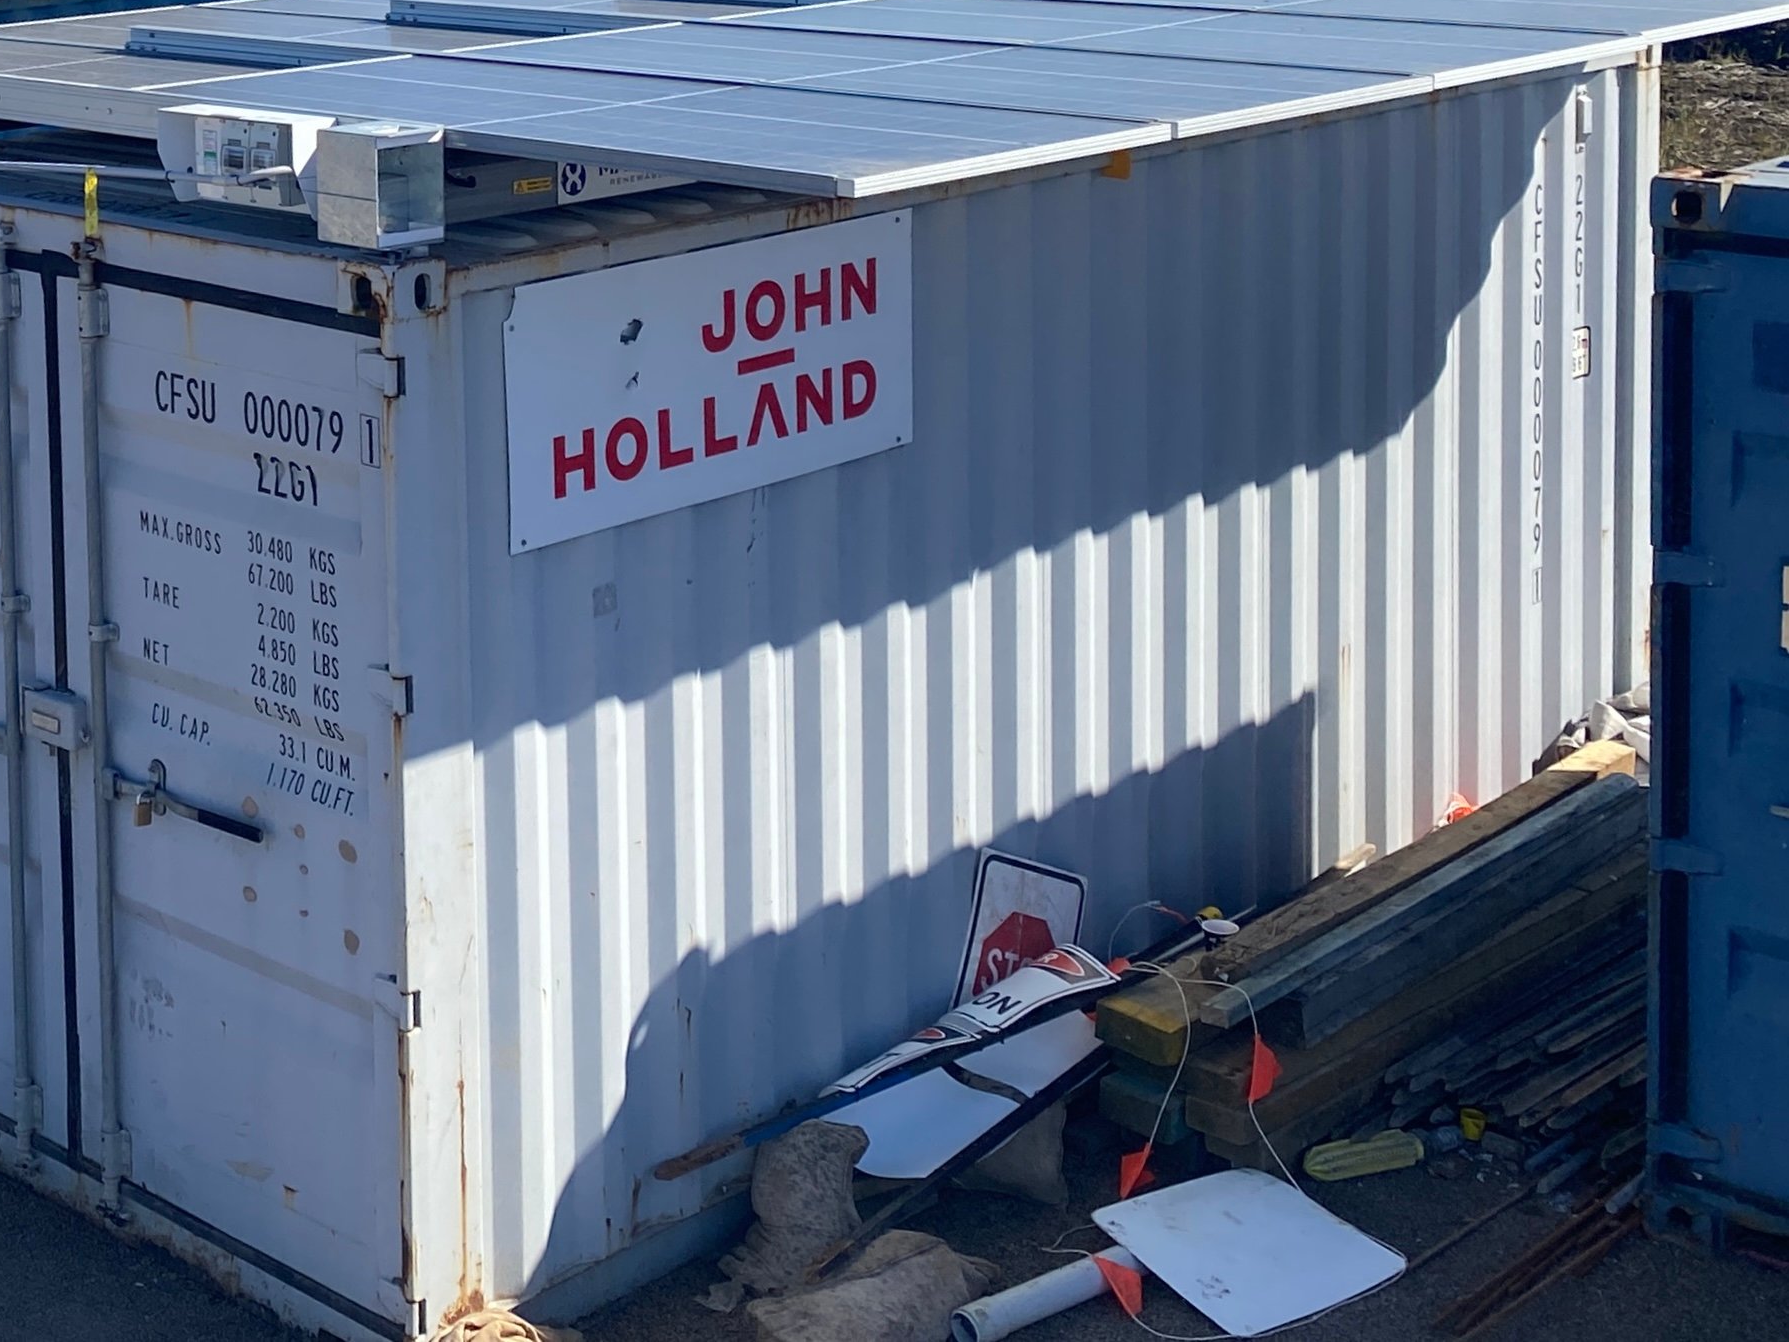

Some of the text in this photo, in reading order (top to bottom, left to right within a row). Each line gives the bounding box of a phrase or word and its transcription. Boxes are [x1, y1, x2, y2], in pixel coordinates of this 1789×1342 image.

[1534, 184, 1543, 326] CFSU
[1574, 174, 1583, 315] 22G1
[701, 258, 877, 353] JOHN
[155, 370, 216, 424] CFSU
[244, 391, 344, 454] 000079
[553, 360, 877, 499] HOLLAND
[1533, 339, 1542, 554] 000079
[253, 452, 318, 507] 22G1
[247, 530, 336, 576] 30.480 KGS
[142, 576, 180, 609] TARE
[248, 563, 338, 608] 67.200 LBS
[257, 603, 339, 647] 2.200 KGS
[143, 637, 169, 666] NET
[258, 634, 340, 680] 4.850 LBS
[250, 663, 340, 712] 28.280 KGS
[180, 713, 210, 746] CAP.
[254, 696, 344, 741] 62.350 LBS
[279, 733, 306, 764] 33.1
[266, 762, 305, 795] 1.170
